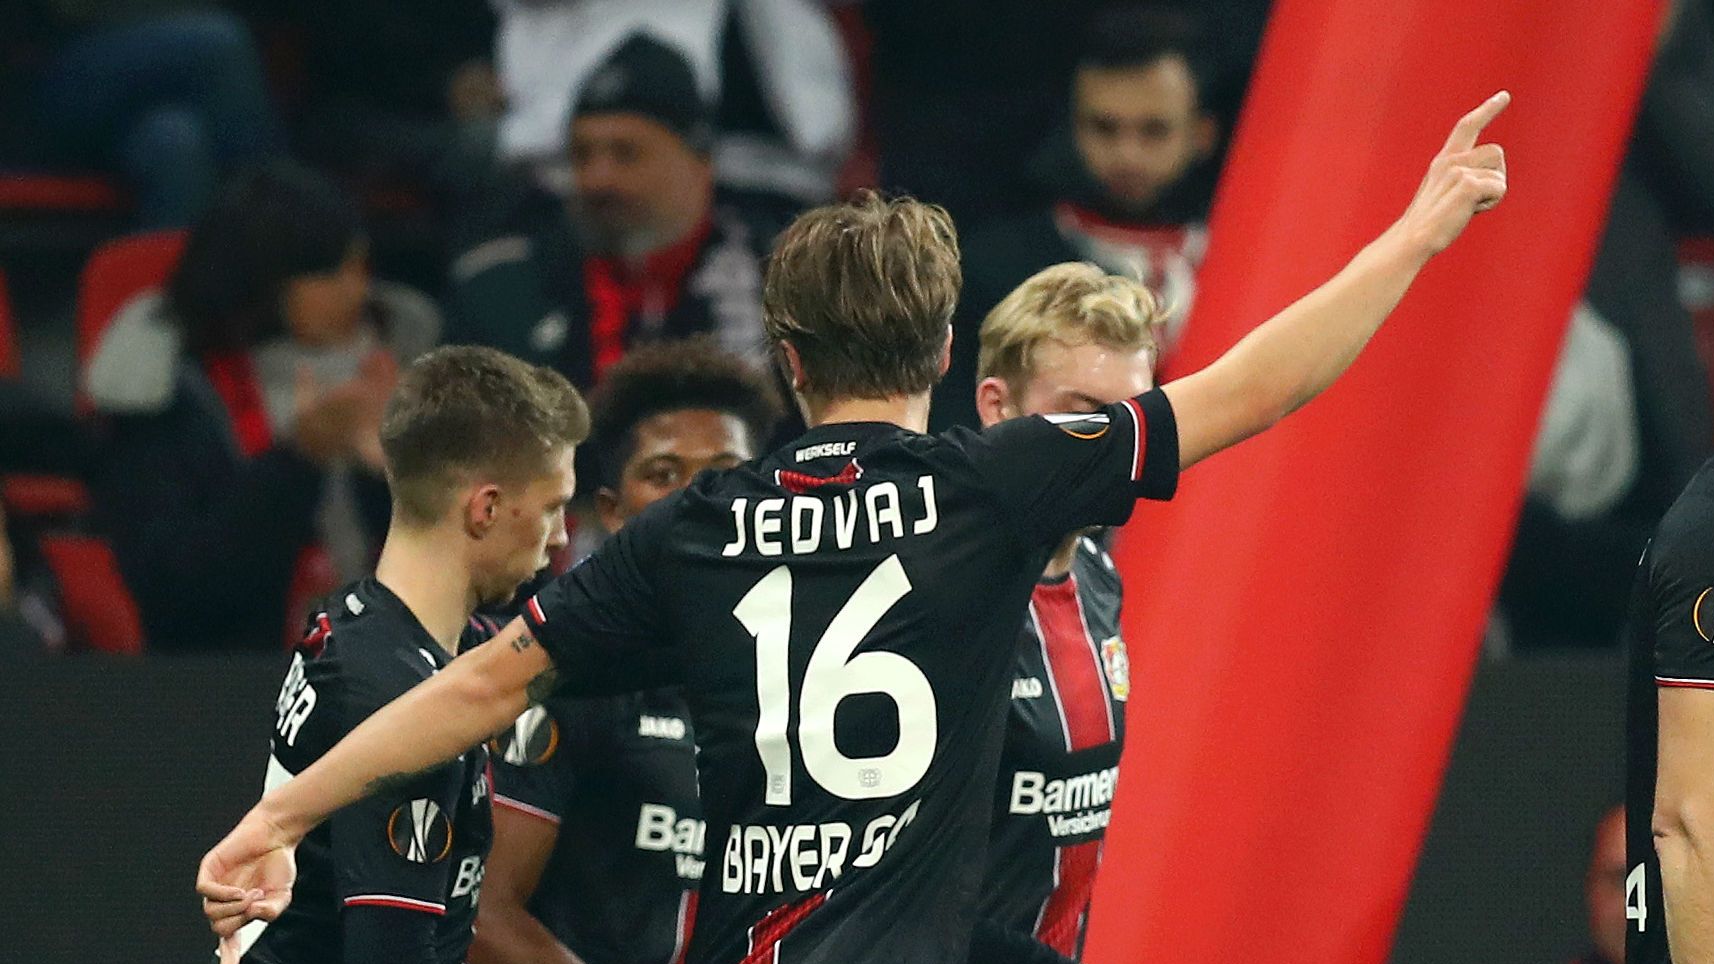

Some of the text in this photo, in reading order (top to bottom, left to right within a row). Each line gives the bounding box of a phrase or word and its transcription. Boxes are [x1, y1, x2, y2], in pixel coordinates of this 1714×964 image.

[796, 441, 856, 463] WERKSELF
[721, 475, 939, 557] JEDVAJ
[732, 553, 938, 806] 16
[722, 821, 852, 895] BAYER
[1625, 862, 1648, 932] 4
